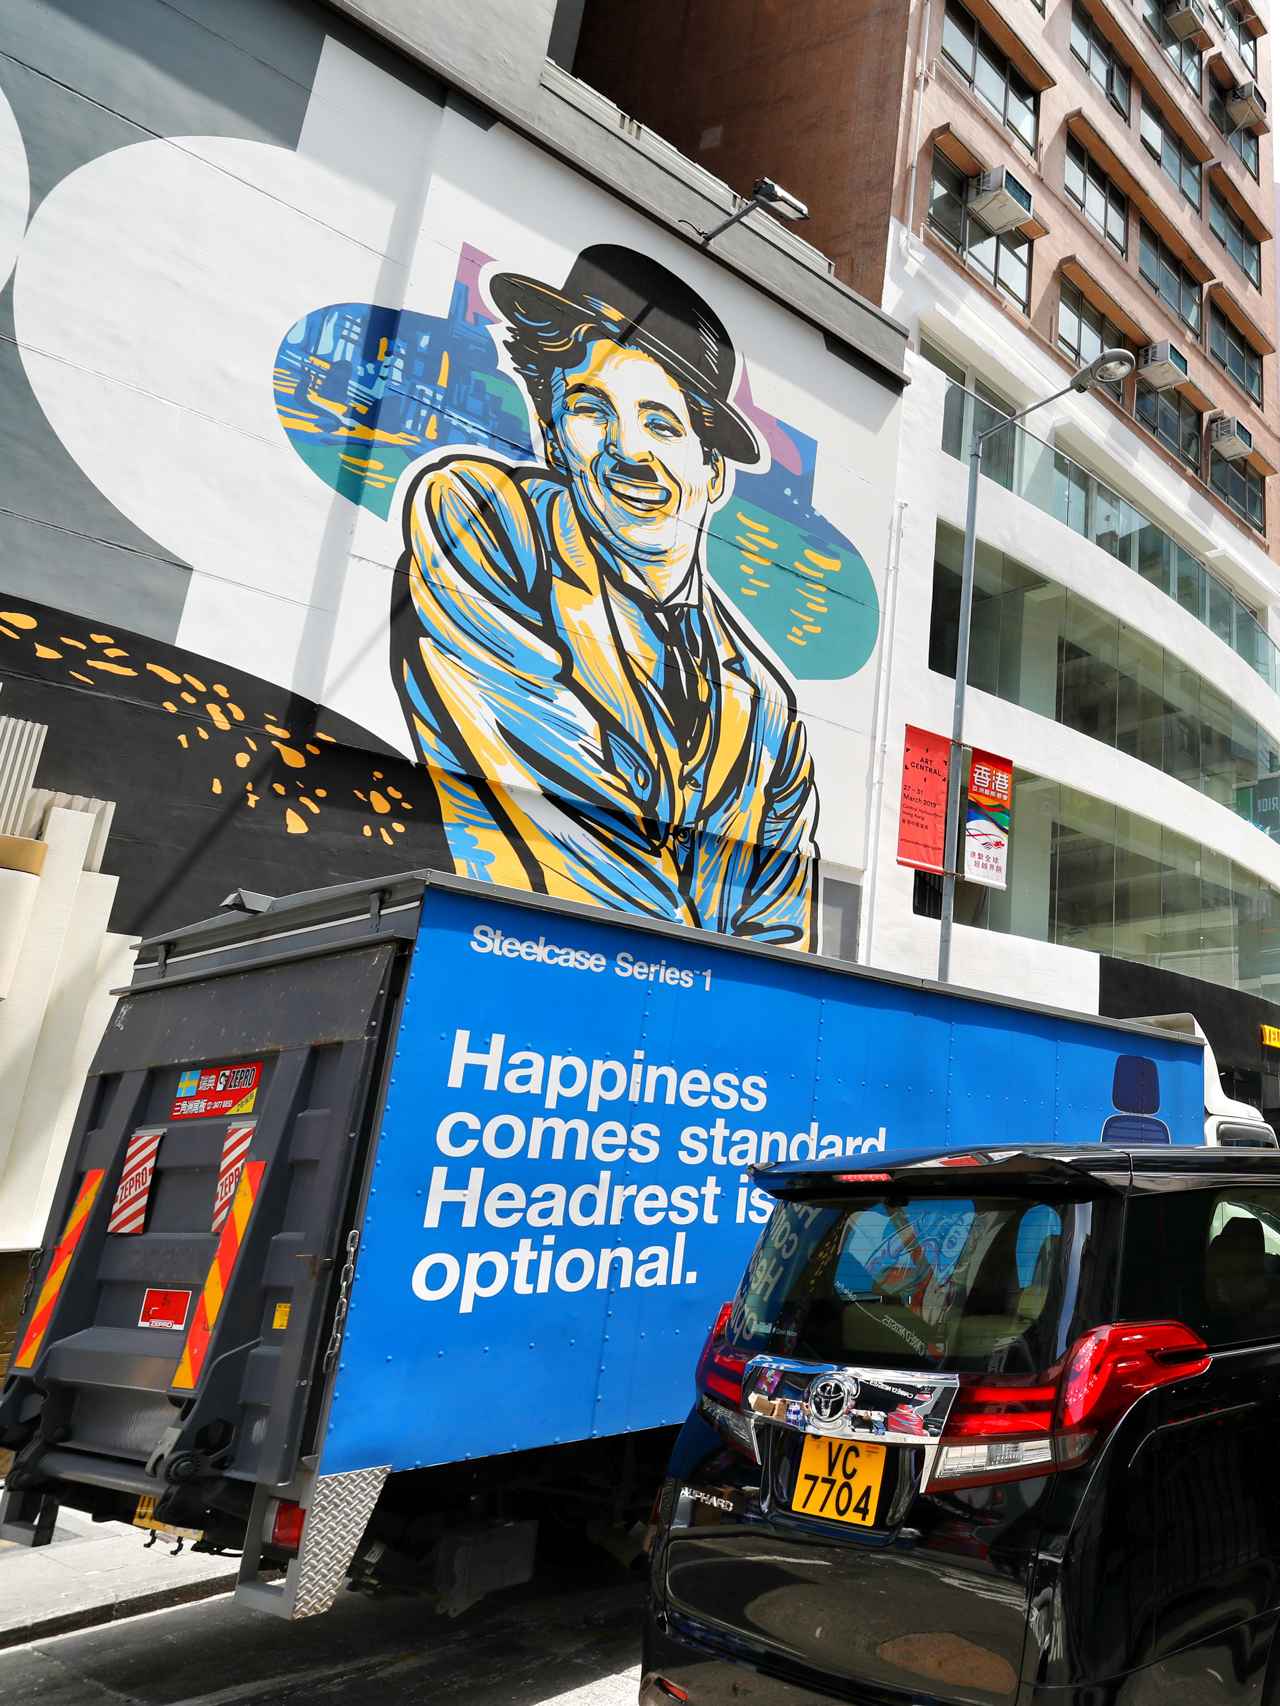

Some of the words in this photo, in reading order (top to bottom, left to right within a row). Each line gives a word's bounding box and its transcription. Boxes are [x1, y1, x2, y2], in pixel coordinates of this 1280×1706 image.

[911, 762, 942, 777] CENTRAL
[920, 757, 933, 766] ART
[904, 784, 911, 792] 27
[916, 788, 923, 796] 31
[972, 785, 1009, 801] 亞洲國際都會
[973, 764, 1010, 794] 香港
[903, 793, 922, 805] March
[923, 799, 937, 809] 2019
[470, 925, 607, 973] Steelcase
[701, 968, 712, 991] 1
[227, 1066, 257, 1090] ZEPRO
[447, 1029, 768, 1113] Happiness
[436, 1111, 660, 1163] comes
[119, 1166, 148, 1205] ZEPRO
[423, 1166, 722, 1228] Headrest
[736, 1174, 777, 1225] is
[411, 1231, 698, 1314] optional.
[150, 1320, 174, 1328] ZEPRO
[828, 1441, 861, 1480] VC
[680, 1486, 734, 1512] ALPHARD
[801, 1473, 873, 1522] 7704
